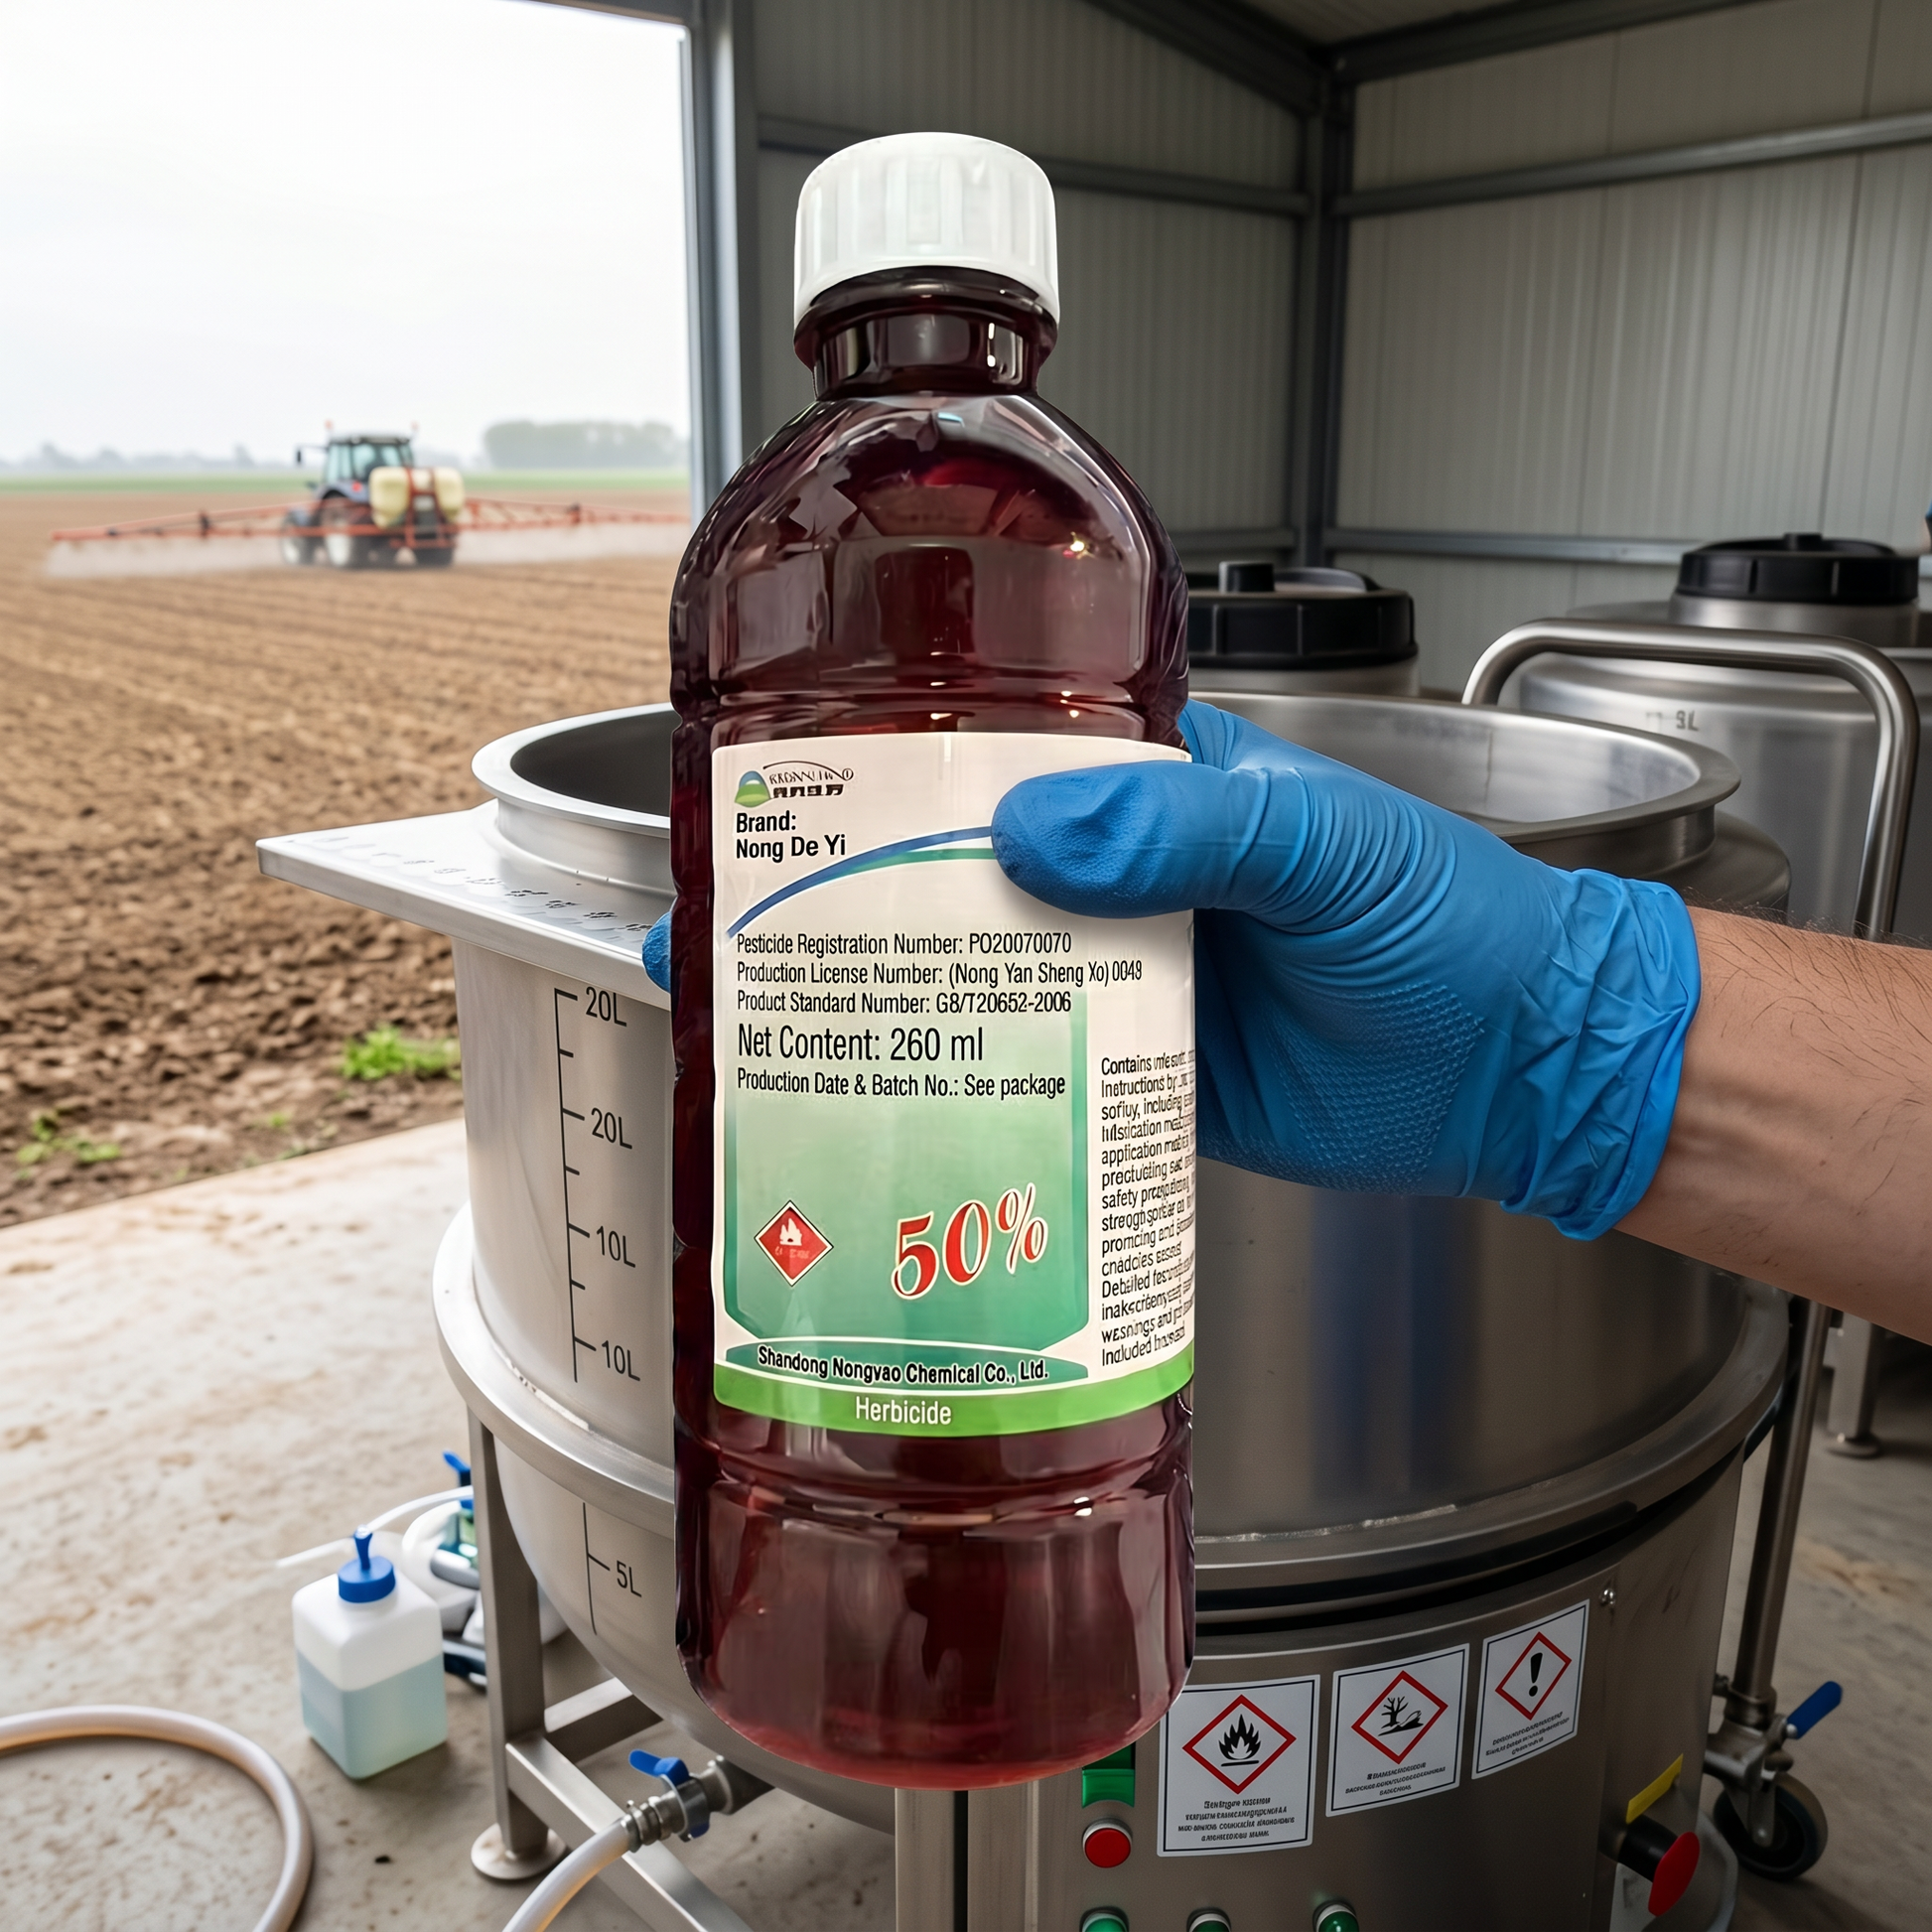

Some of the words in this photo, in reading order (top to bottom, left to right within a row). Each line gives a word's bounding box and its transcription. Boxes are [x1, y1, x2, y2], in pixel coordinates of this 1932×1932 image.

[736, 809, 796, 833] Brand:
[736, 838, 783, 864] Nong
[791, 836, 819, 857] De
[824, 833, 845, 856] Yi
[738, 933, 793, 954] Pesticide
[798, 933, 888, 959] Registration
[894, 933, 963, 954] Number:
[738, 961, 806, 983] Production
[810, 962, 868, 984] License
[874, 962, 943, 984] Number:
[949, 961, 999, 990] (Nong
[1005, 962, 1033, 984] Yan
[1038, 961, 1084, 988] Sheng
[1088, 960, 1109, 988] Xo)
[585, 986, 627, 1027] 20L
[738, 990, 786, 1012] Product
[790, 991, 856, 1014] Standard
[861, 992, 930, 1014] Number:
[739, 1023, 772, 1058] Net
[779, 1025, 881, 1060] Content:
[890, 1027, 941, 1061] 260
[950, 1026, 983, 1061] ml
[1101, 1054, 1152, 1076] Contains
[738, 1067, 809, 1093] Production
[814, 1071, 849, 1095] Date
[854, 1073, 867, 1095] &
[872, 1073, 919, 1096] Batch
[924, 1073, 959, 1096] No.:
[964, 1073, 996, 1096] See
[1001, 1072, 1066, 1101] package
[591, 1107, 632, 1150] 20L
[596, 1225, 636, 1268] 10L
[891, 1181, 1048, 1301] 50%
[602, 1340, 640, 1382] 10L
[758, 1344, 829, 1379] Shandong
[984, 1362, 1016, 1384] Co.,
[856, 1395, 952, 1425] Herbicide
[616, 1560, 642, 1597] 5L
